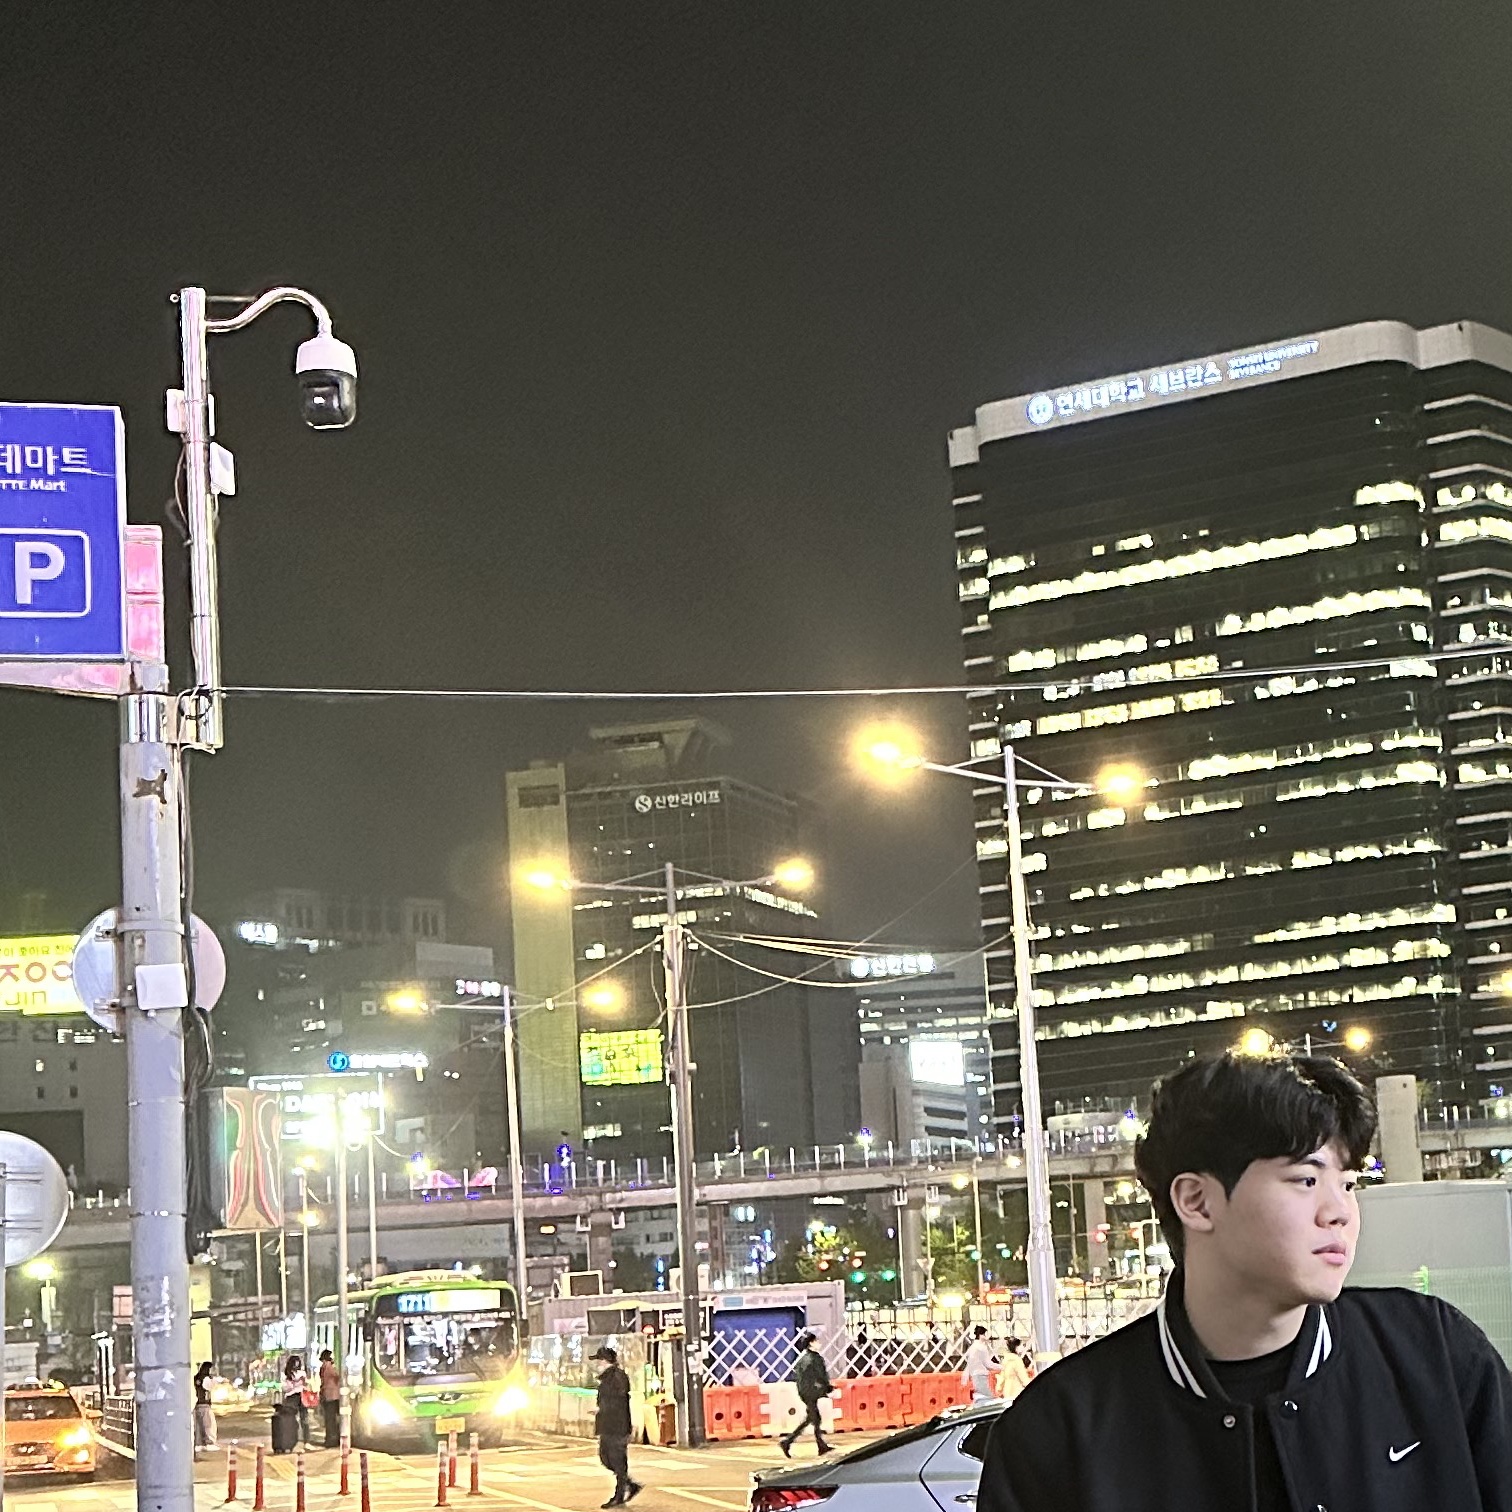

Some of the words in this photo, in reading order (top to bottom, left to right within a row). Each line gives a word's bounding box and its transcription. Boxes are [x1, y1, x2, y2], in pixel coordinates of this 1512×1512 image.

[1055, 377, 1146, 418] 연세대학교
[1148, 361, 1223, 396] 세브란스
[30, 478, 67, 493] Mart
[14, 541, 66, 605] P
[654, 790, 721, 809] 신한라이프
